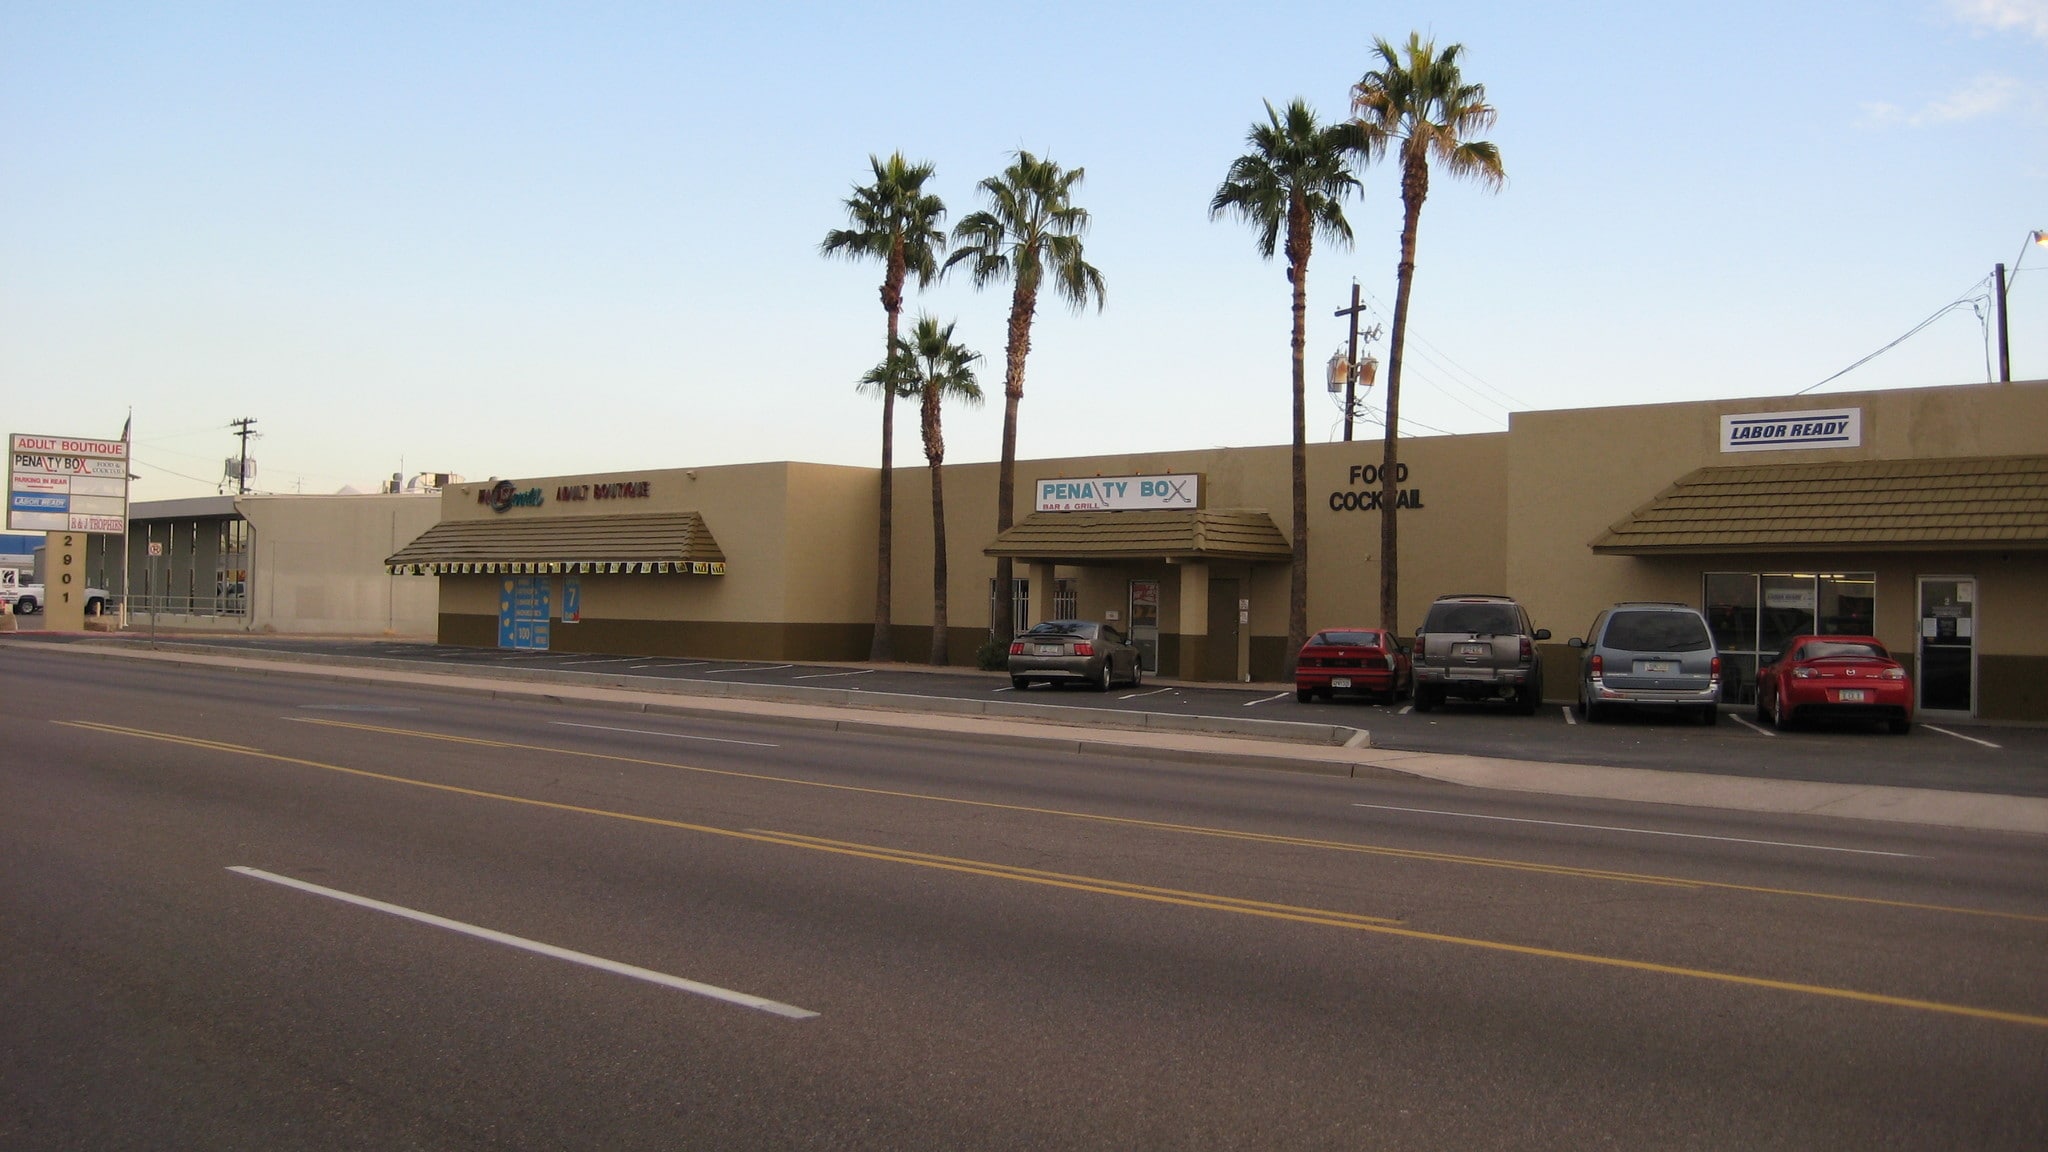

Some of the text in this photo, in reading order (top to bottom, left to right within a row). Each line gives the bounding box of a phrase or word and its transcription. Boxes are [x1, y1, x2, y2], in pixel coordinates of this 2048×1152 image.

[1731, 421, 1849, 440] LABOR READY
[18, 437, 122, 454] ADULT BOUTIQUE
[15, 455, 91, 474] PENALTY BOX
[14, 476, 41, 484] PARKING
[556, 484, 590, 501] ADULT
[593, 481, 650, 499] BOUTIQUE
[1042, 480, 1191, 507] PENALTY BOX
[1329, 489, 1424, 511] COCKAIL
[90, 518, 123, 531] TROPHIES
